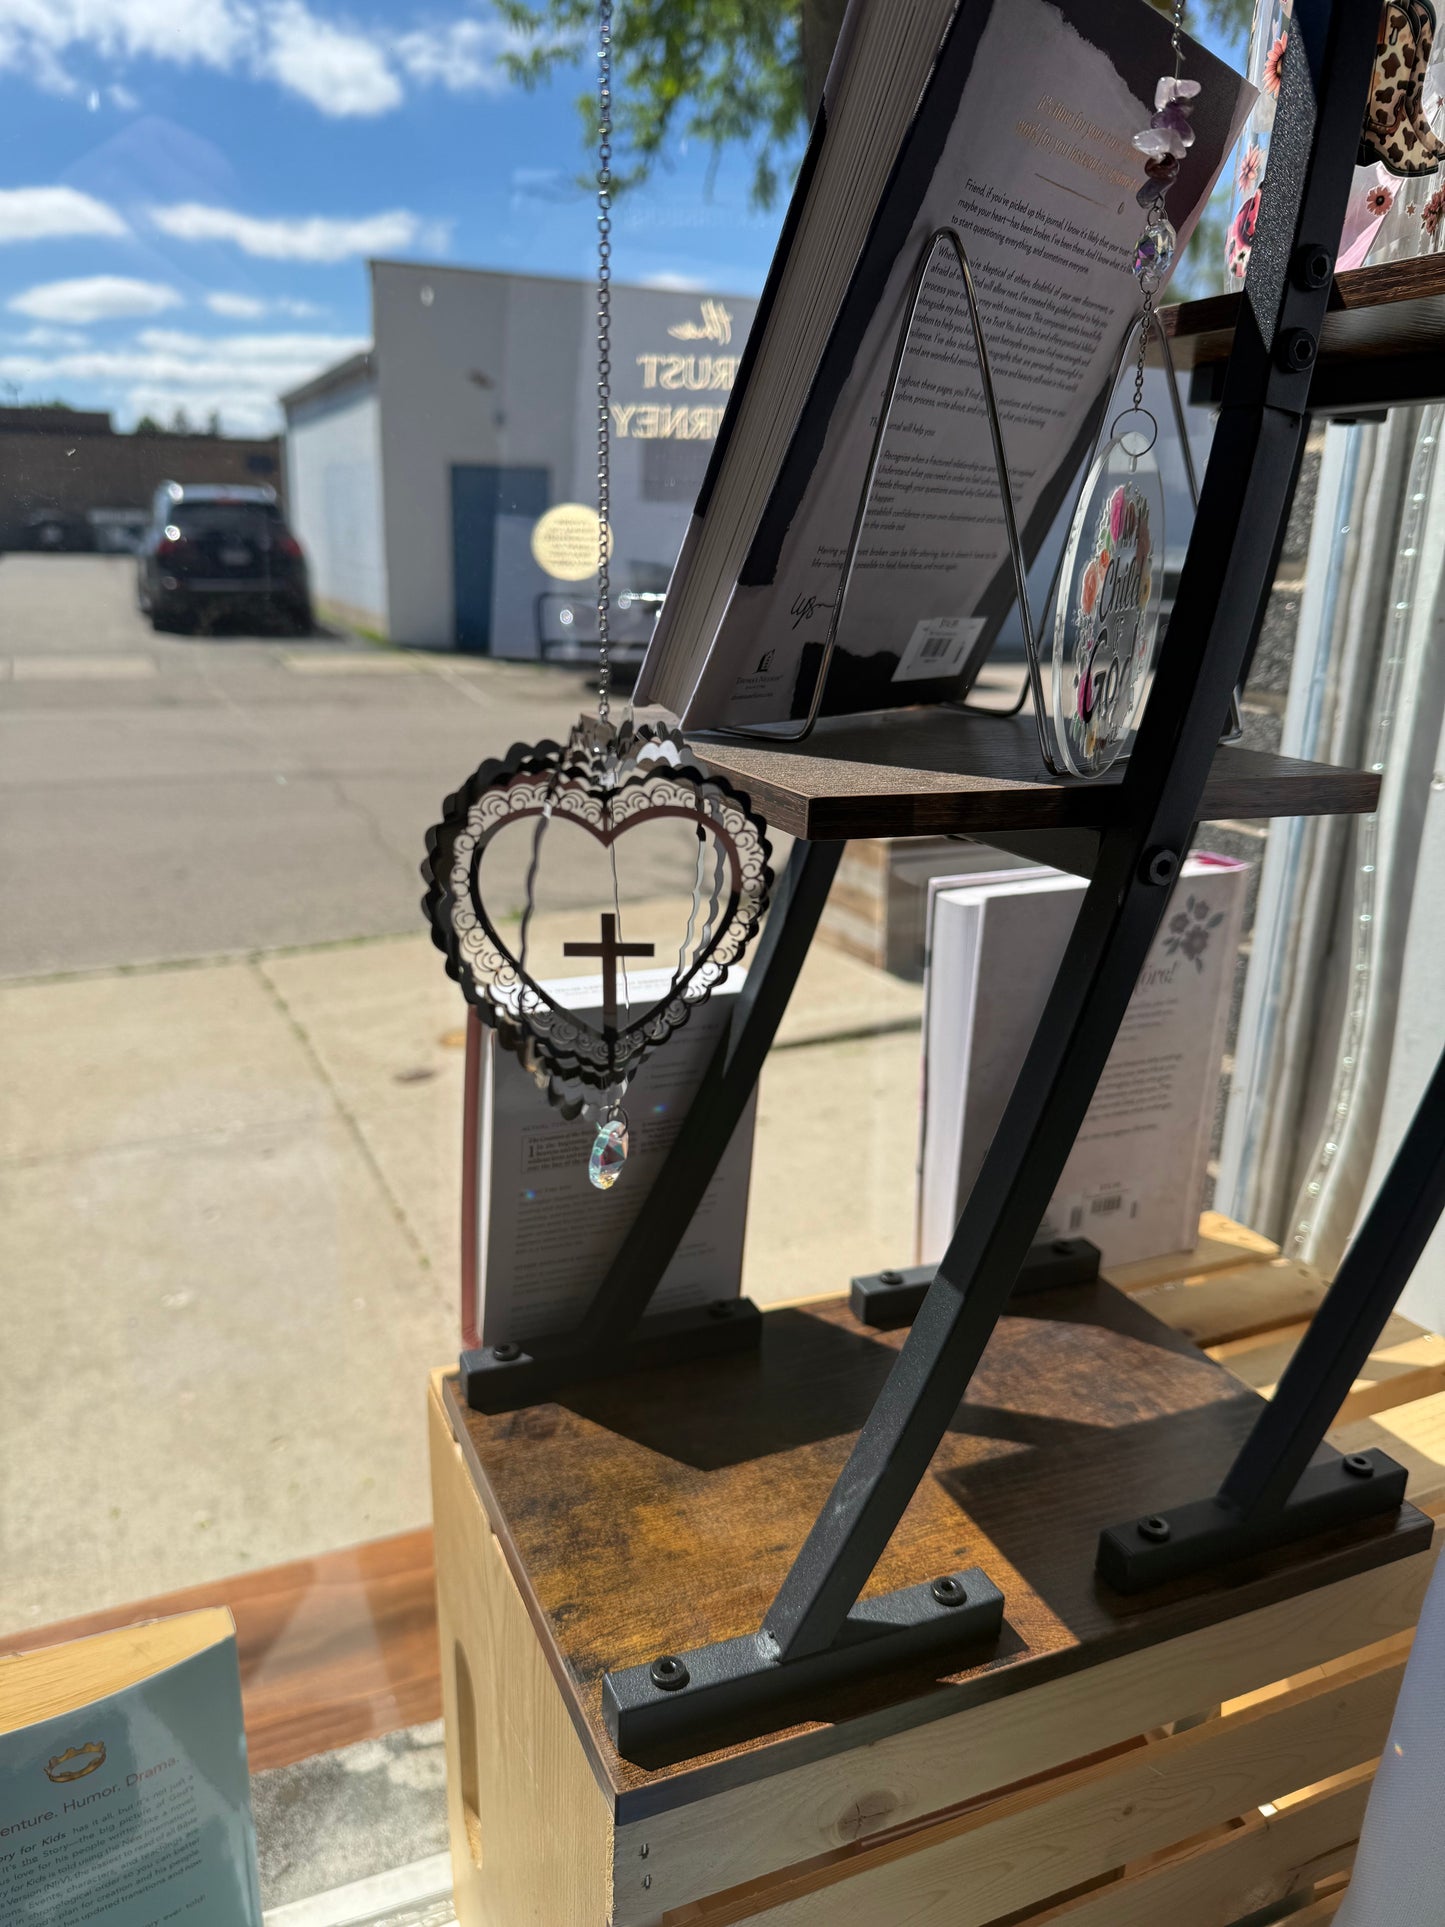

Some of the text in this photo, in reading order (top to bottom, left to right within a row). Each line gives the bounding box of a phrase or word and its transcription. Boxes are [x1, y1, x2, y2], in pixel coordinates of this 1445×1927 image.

[965, 177, 987, 196] Friend,
[986, 187, 994, 197] if
[990, 193, 1010, 205] you've
[1008, 199, 1029, 212] picked
[1027, 208, 1036, 219] up
[1035, 209, 1046, 220] this
[951, 212, 960, 222] to
[959, 216, 975, 228] start
[958, 197, 979, 211] maybe
[977, 206, 992, 216] your
[1020, 219, 1034, 233] been
[0, 1758, 179, 1837] enture. Humor. Drama.
[20, 1844, 37, 1854] for
[41, 1832, 66, 1846] Kids
[13, 1869, 34, 1881] love
[37, 1861, 52, 1871] for
[21, 1856, 39, 1866] the
[25, 1875, 47, 1887] Kids
